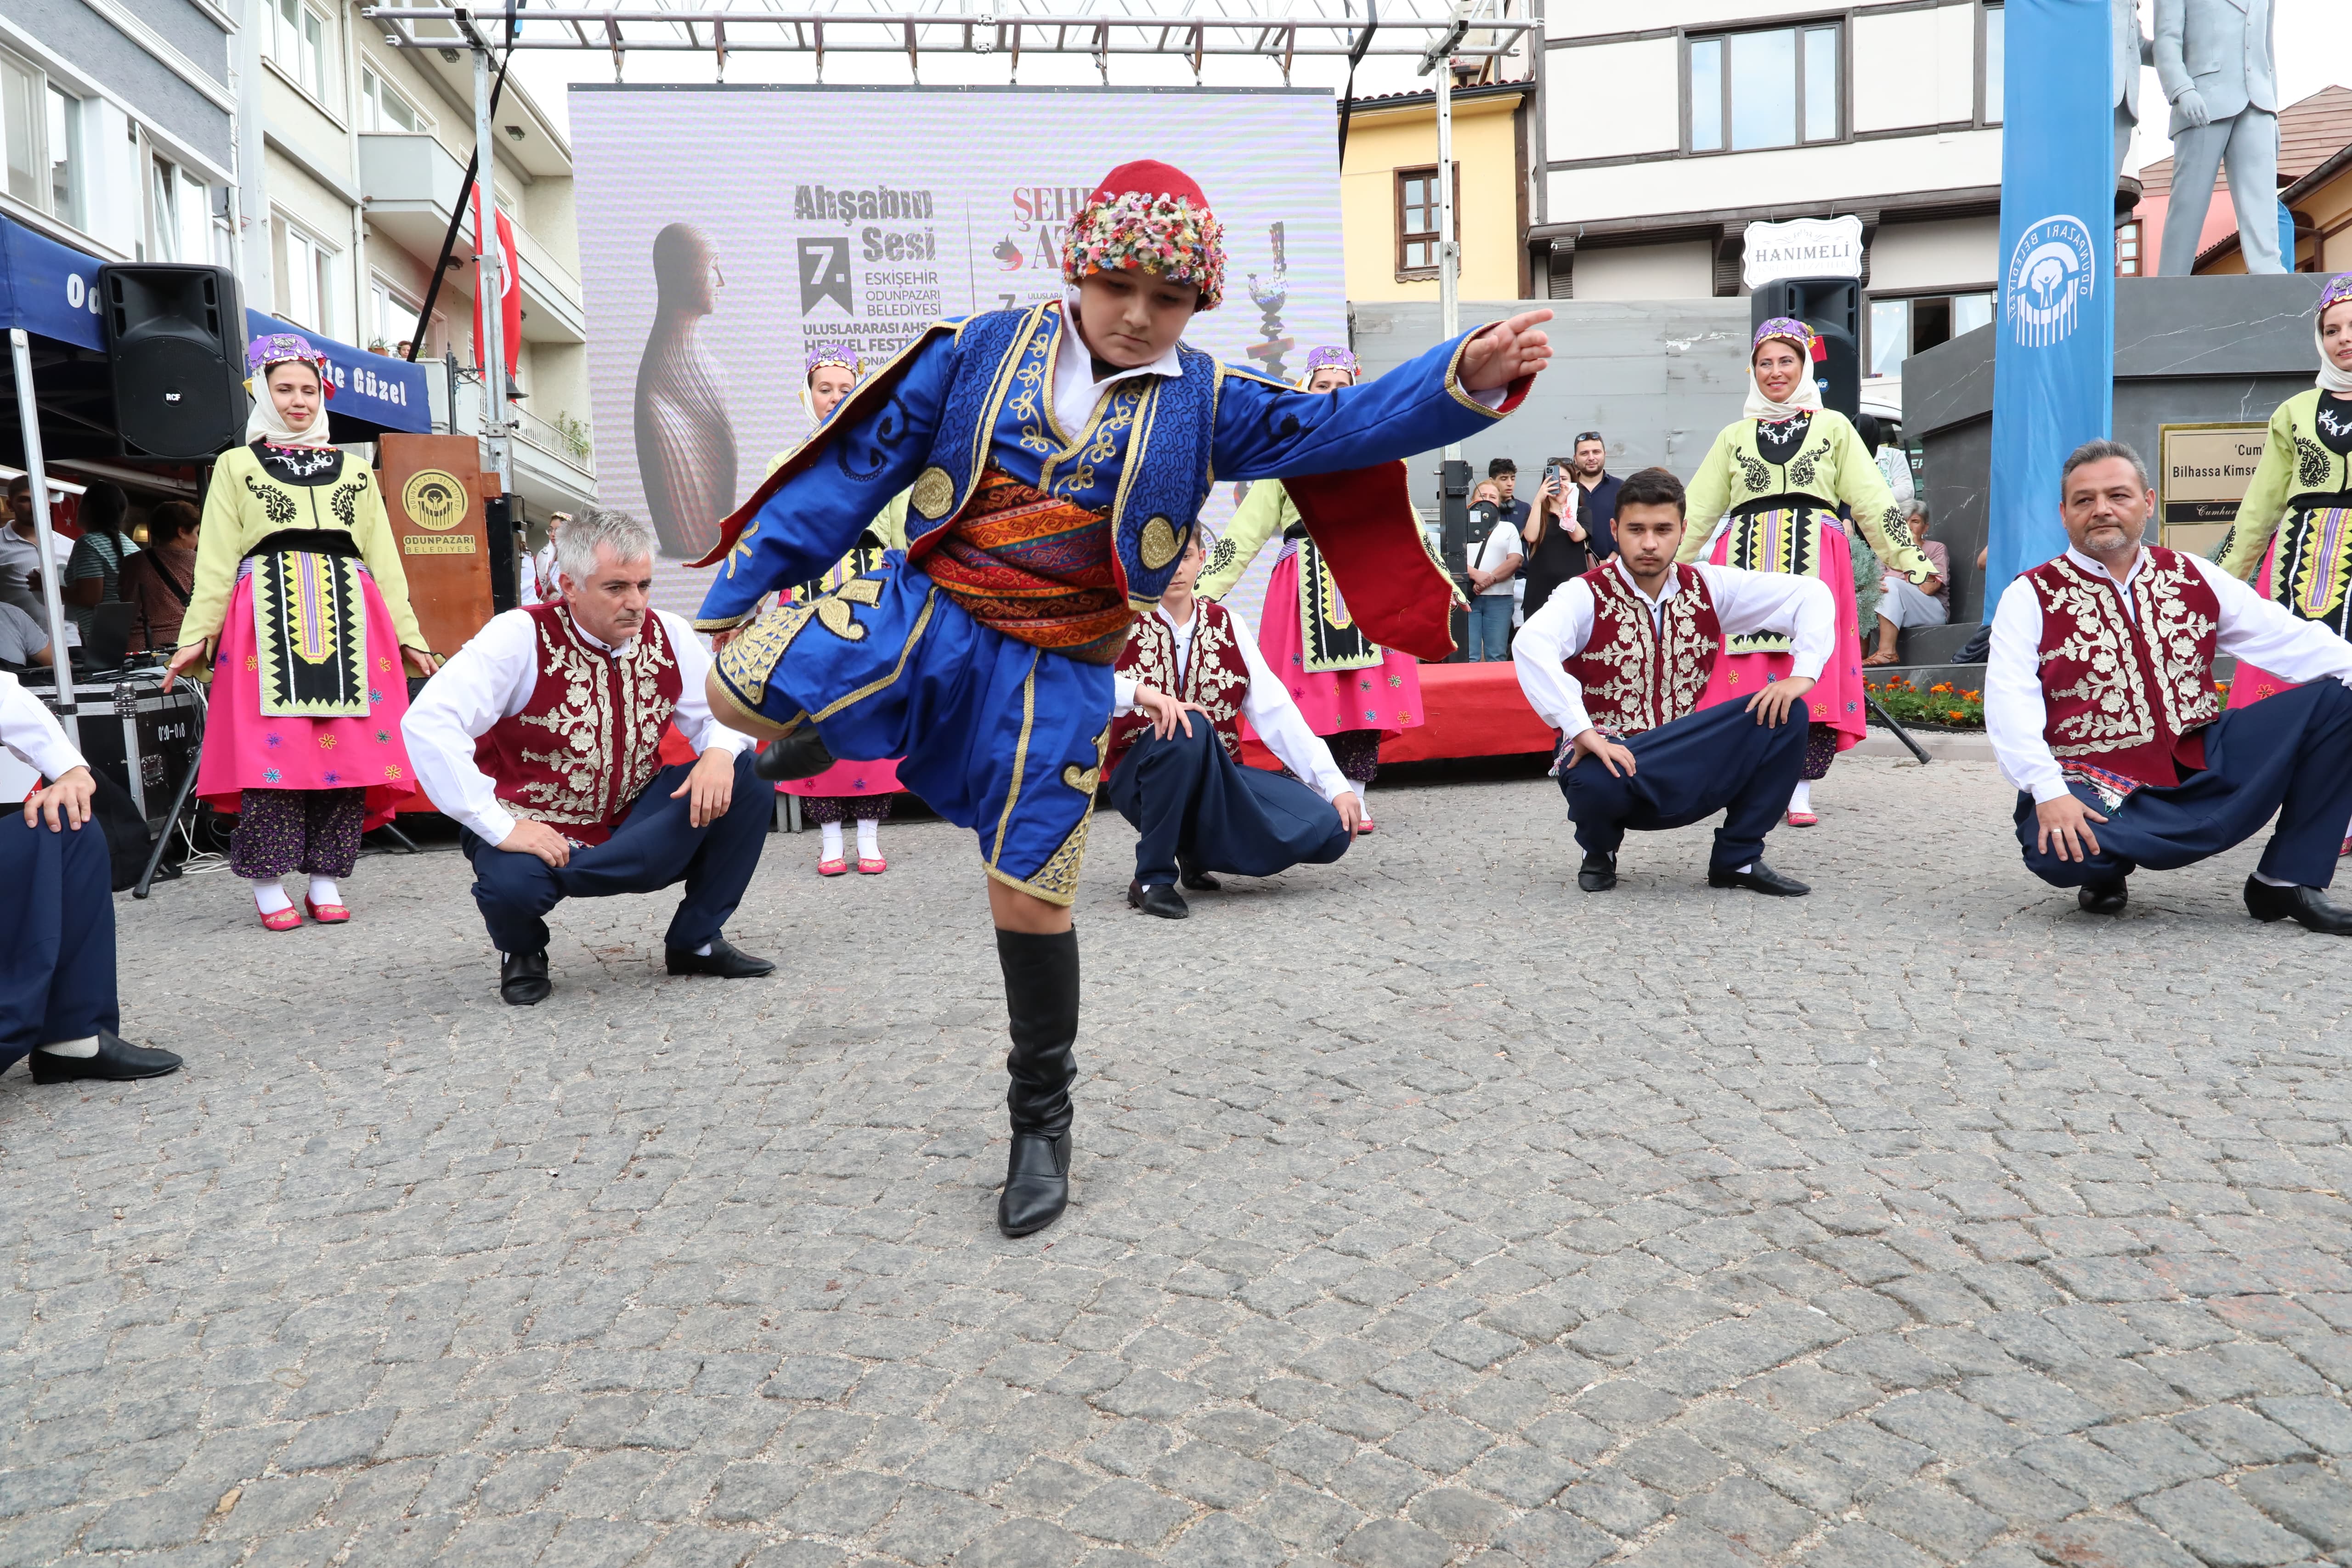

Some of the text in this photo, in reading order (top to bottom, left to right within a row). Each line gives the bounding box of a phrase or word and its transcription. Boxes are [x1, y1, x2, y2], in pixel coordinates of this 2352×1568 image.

[794, 185, 933, 226] Ahşabın
[862, 226, 936, 262] Sesi
[1756, 241, 1849, 262] HANIMELİ
[806, 246, 845, 284] 7.
[865, 269, 939, 288] ESKİŞEHİR
[866, 290, 940, 301] ODUNPAZARI
[867, 301, 941, 316] BELEDİYESİ
[803, 322, 899, 335] ULUSLARARASI
[869, 334, 913, 352] FESTİ
[353, 368, 407, 406] Güzel
[2173, 465, 2221, 478] Bilhassa
[410, 476, 435, 509] ODUNPAZARI
[2197, 504, 2239, 517] Cumhur
[405, 536, 474, 544] ODUNPAZARI
